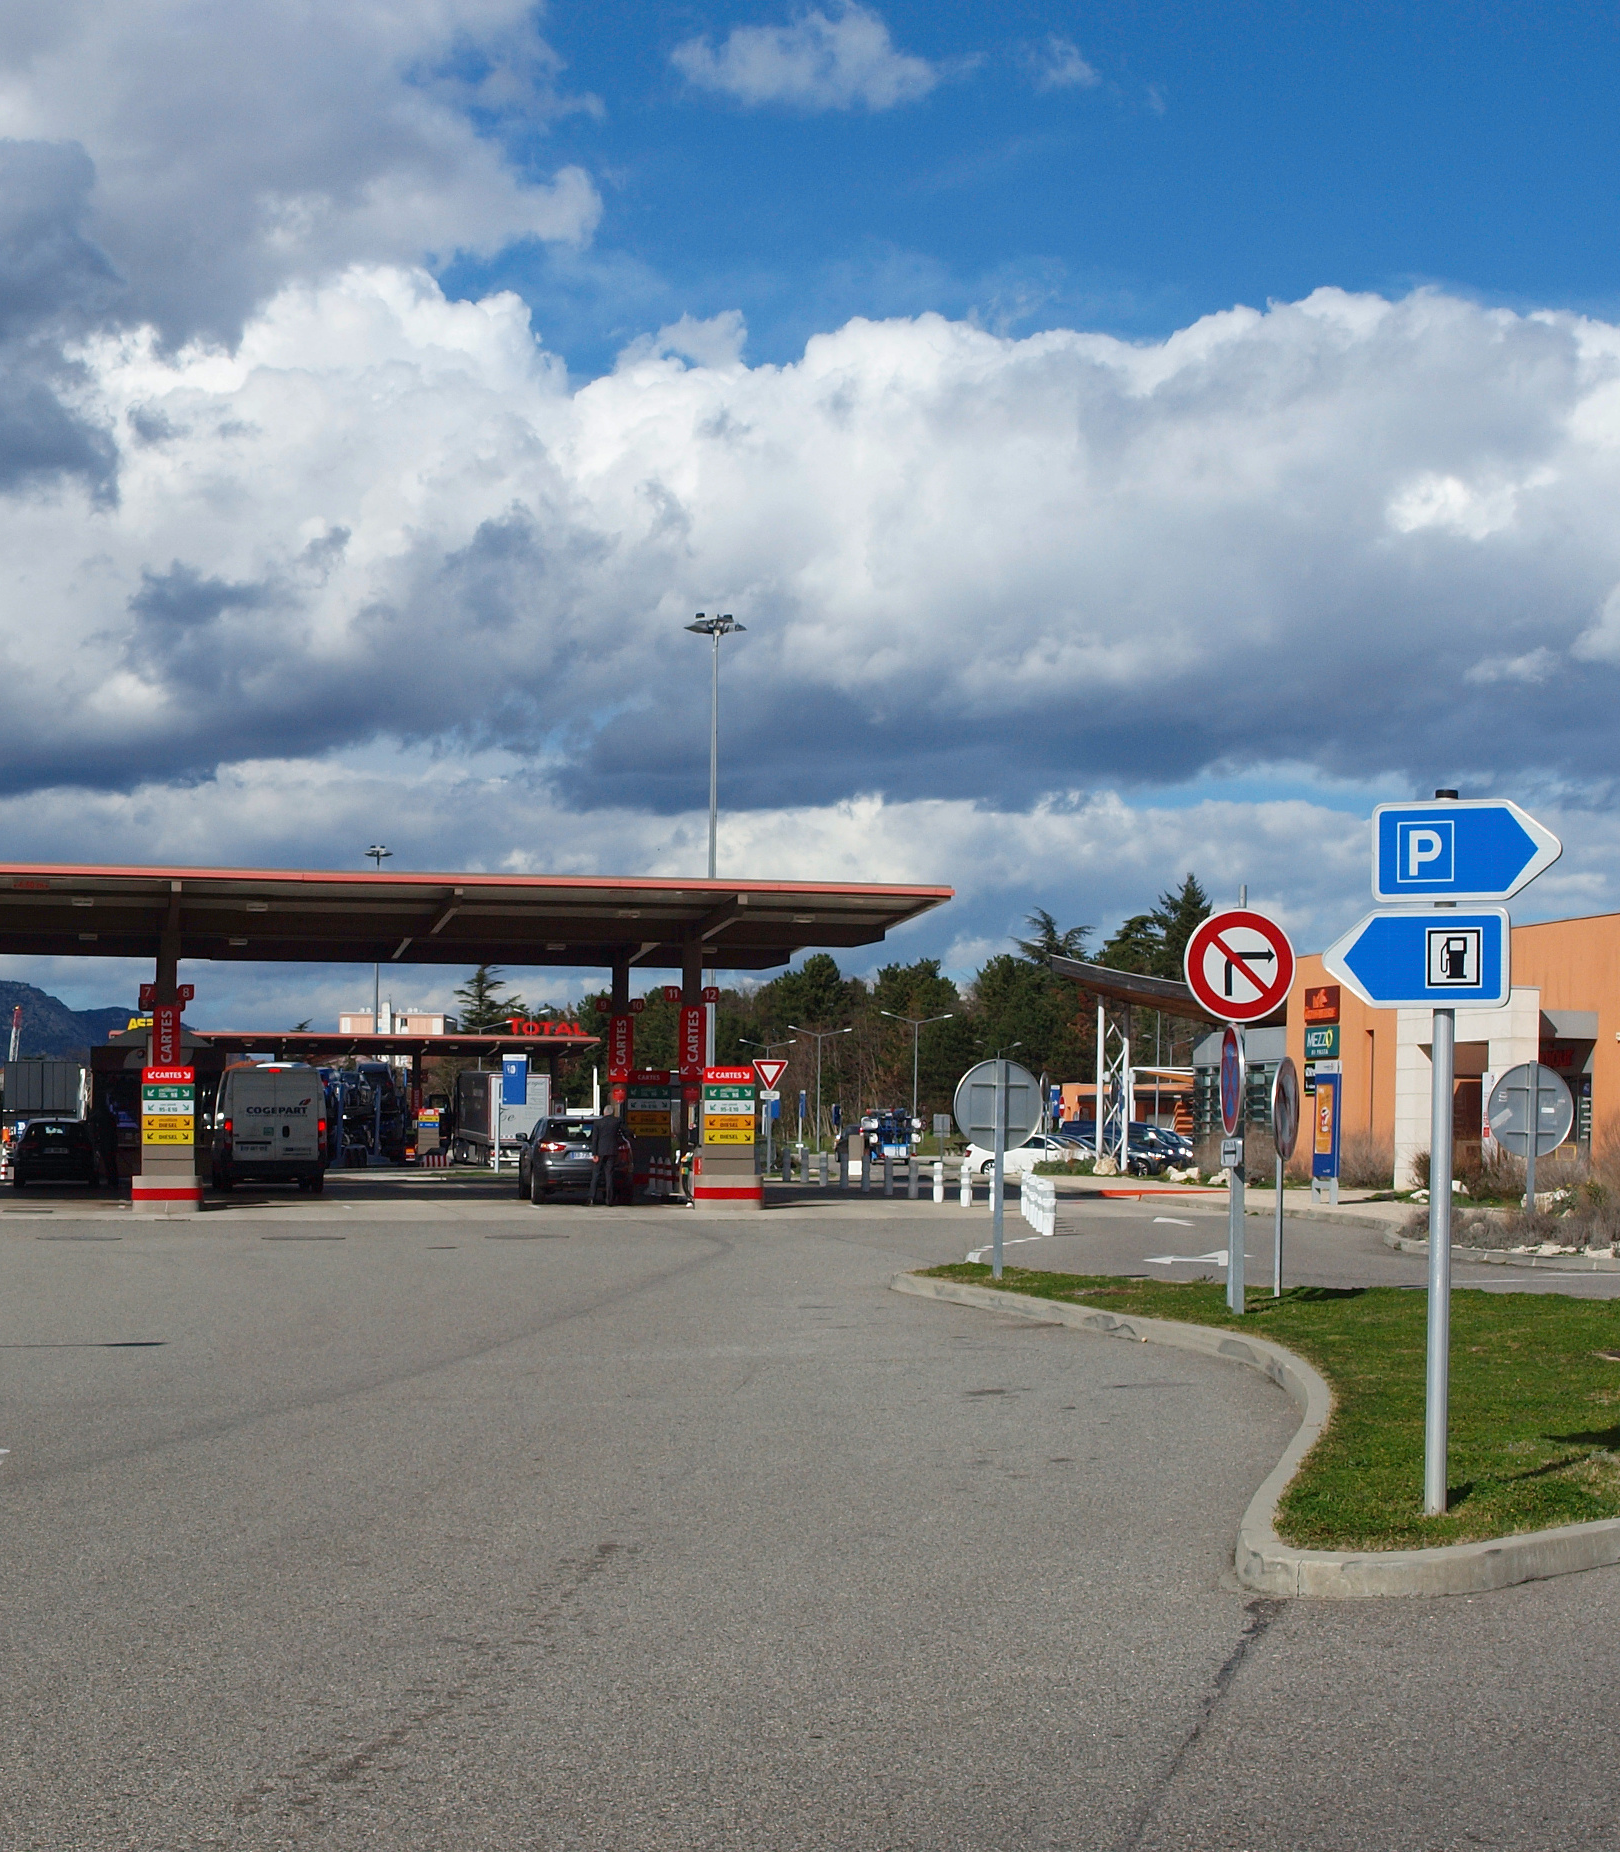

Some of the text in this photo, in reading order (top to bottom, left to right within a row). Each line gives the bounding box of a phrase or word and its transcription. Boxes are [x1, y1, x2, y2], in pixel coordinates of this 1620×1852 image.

[1409, 829, 1443, 876] P
[145, 986, 151, 997] 7
[182, 987, 190, 998] 8
[668, 989, 678, 999] 11
[705, 989, 717, 1000] 12
[506, 1017, 588, 1036] TOTAL
[160, 1010, 173, 1063] CARTES
[616, 1020, 627, 1065] CARTES
[687, 1010, 700, 1063] CARTES
[1307, 1028, 1334, 1049] MEZZO
[246, 1106, 308, 1115] COGEPART
